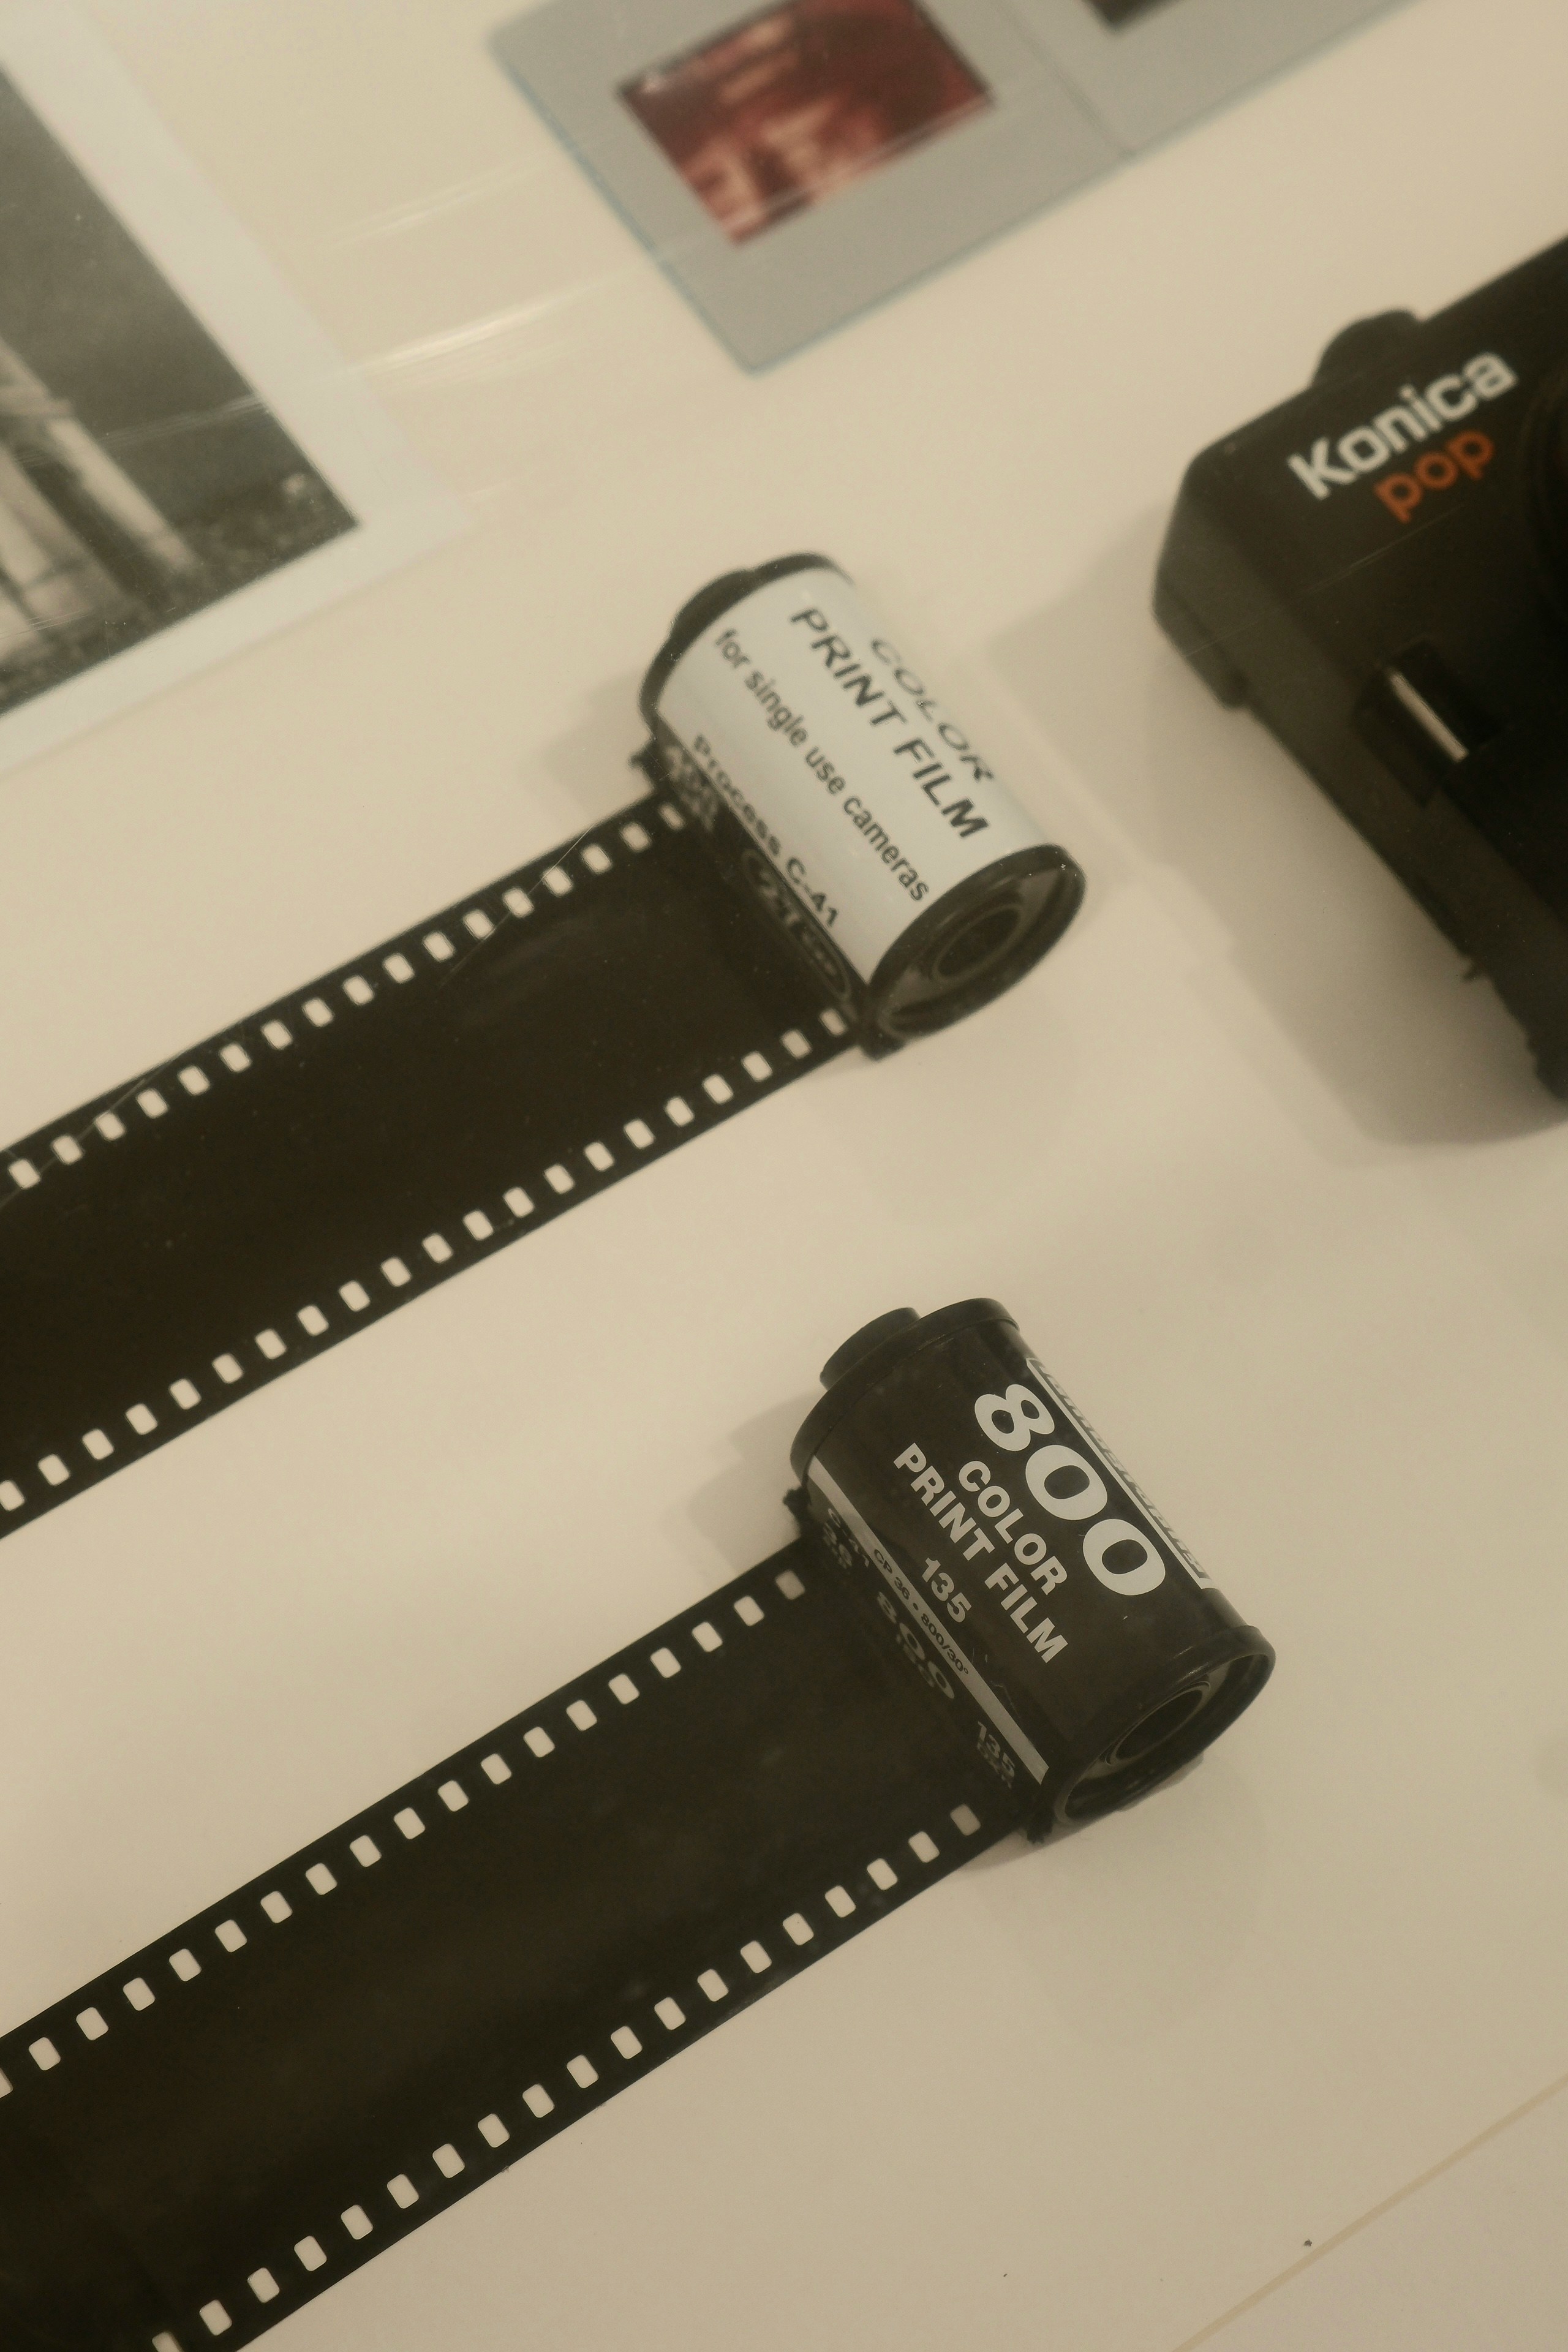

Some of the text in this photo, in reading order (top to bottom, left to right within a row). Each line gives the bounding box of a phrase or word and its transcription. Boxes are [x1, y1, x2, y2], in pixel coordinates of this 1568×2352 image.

[1287, 352, 1517, 500] Konica
[1374, 431, 1494, 524] pop
[714, 628, 929, 902] for single use cameras
[791, 608, 990, 840] PRINT FILM
[871, 638, 995, 783] COLOR
[693, 736, 782, 856] Process
[787, 858, 838, 926] C-41
[894, 1443, 1068, 1664] PRINT FILM
[959, 1461, 1068, 1595] COLOR
[974, 1384, 1166, 1596] 800
[873, 1549, 893, 1575] CP
[894, 1578, 910, 1600] 36
[876, 1591, 955, 1699] 800
[922, 1557, 972, 1623] 135
[978, 1721, 1016, 1777] 135
